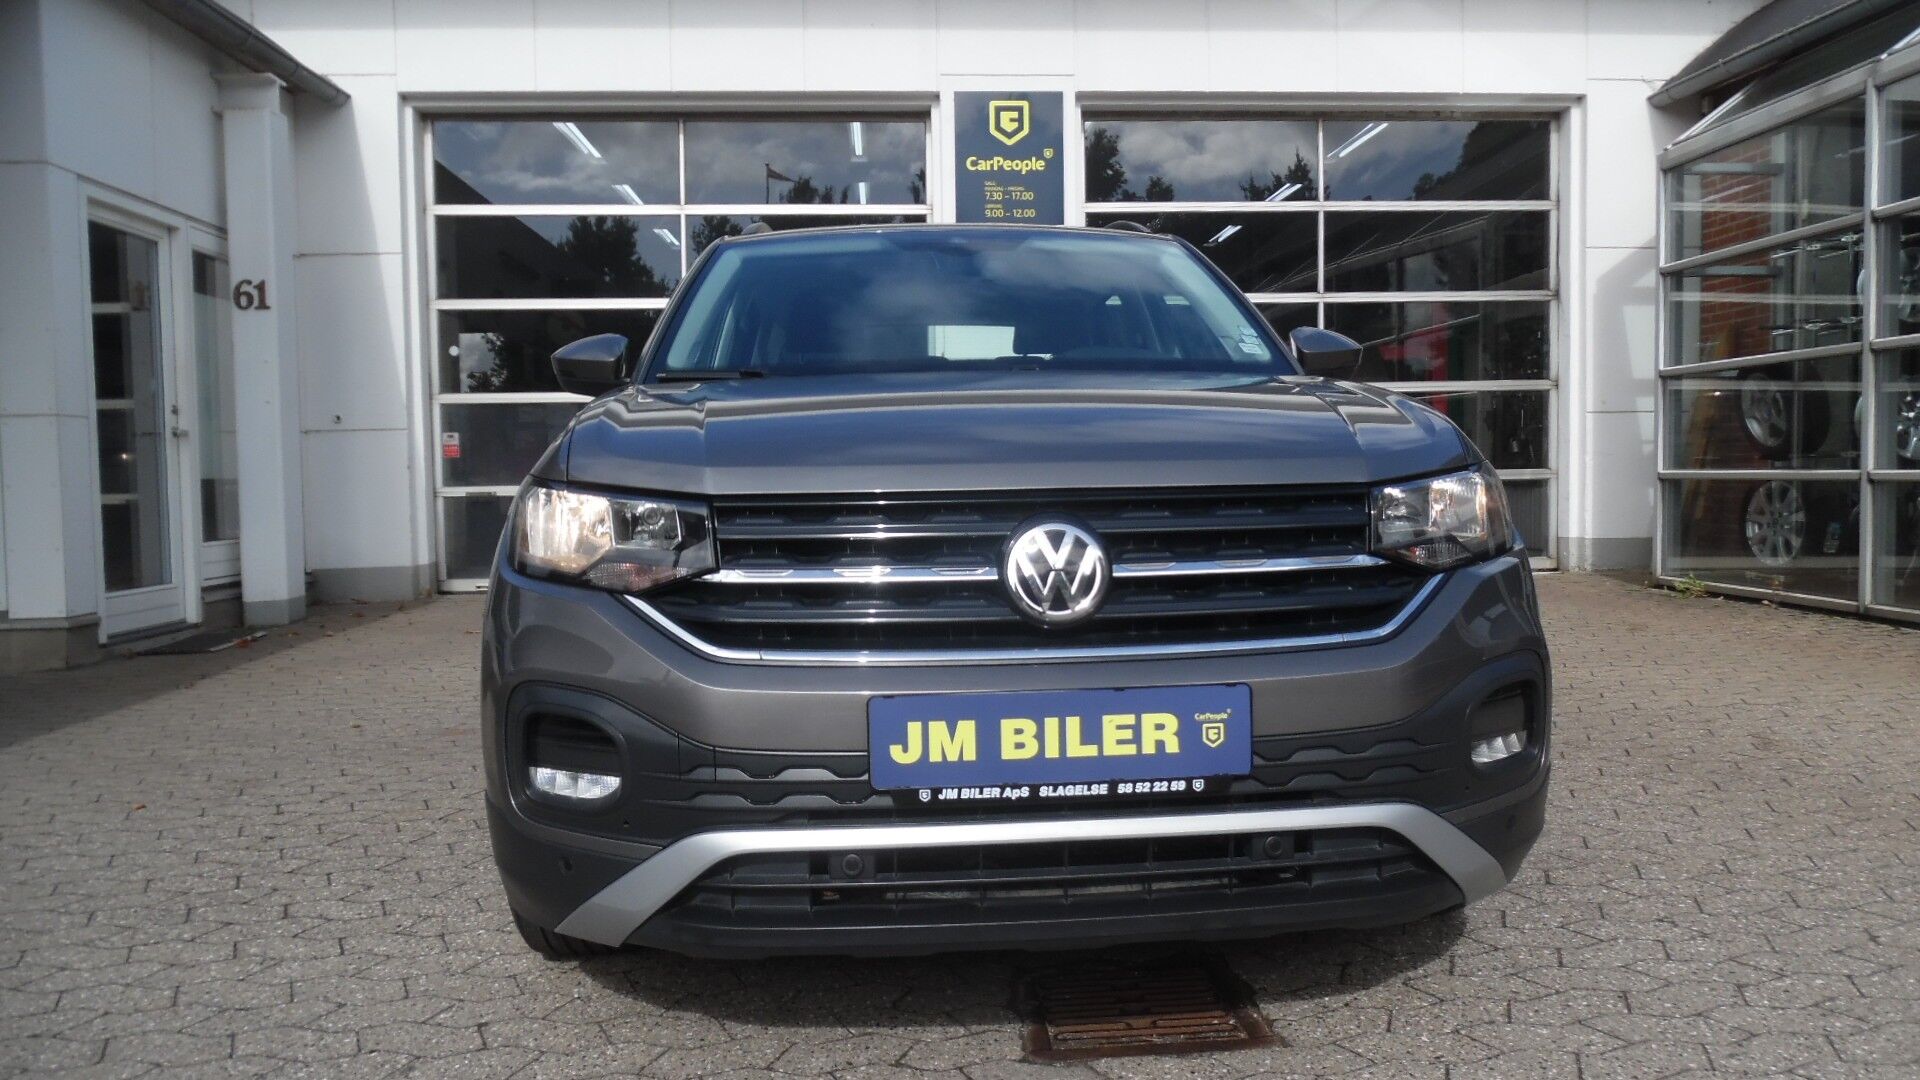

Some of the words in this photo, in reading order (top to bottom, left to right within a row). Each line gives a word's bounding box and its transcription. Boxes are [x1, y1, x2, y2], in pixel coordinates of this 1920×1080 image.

[966, 156, 1046, 175] CarPeople
[984, 191, 1003, 200] 7.30
[1011, 191, 1034, 200] 17.00
[984, 208, 1004, 218] 9.00
[1012, 208, 1036, 218] 12.00
[233, 279, 271, 310] 61
[889, 720, 976, 764] JM
[1000, 713, 1180, 760] BILER
[938, 788, 959, 800] JM
[960, 787, 1001, 799] BILER
[1002, 786, 1030, 800] ApS
[1039, 784, 1109, 797] SLAGELSE
[1117, 783, 1133, 793] 58
[1135, 782, 1151, 792] 52
[1152, 781, 1168, 792] 22
[1170, 780, 1186, 791] 59
